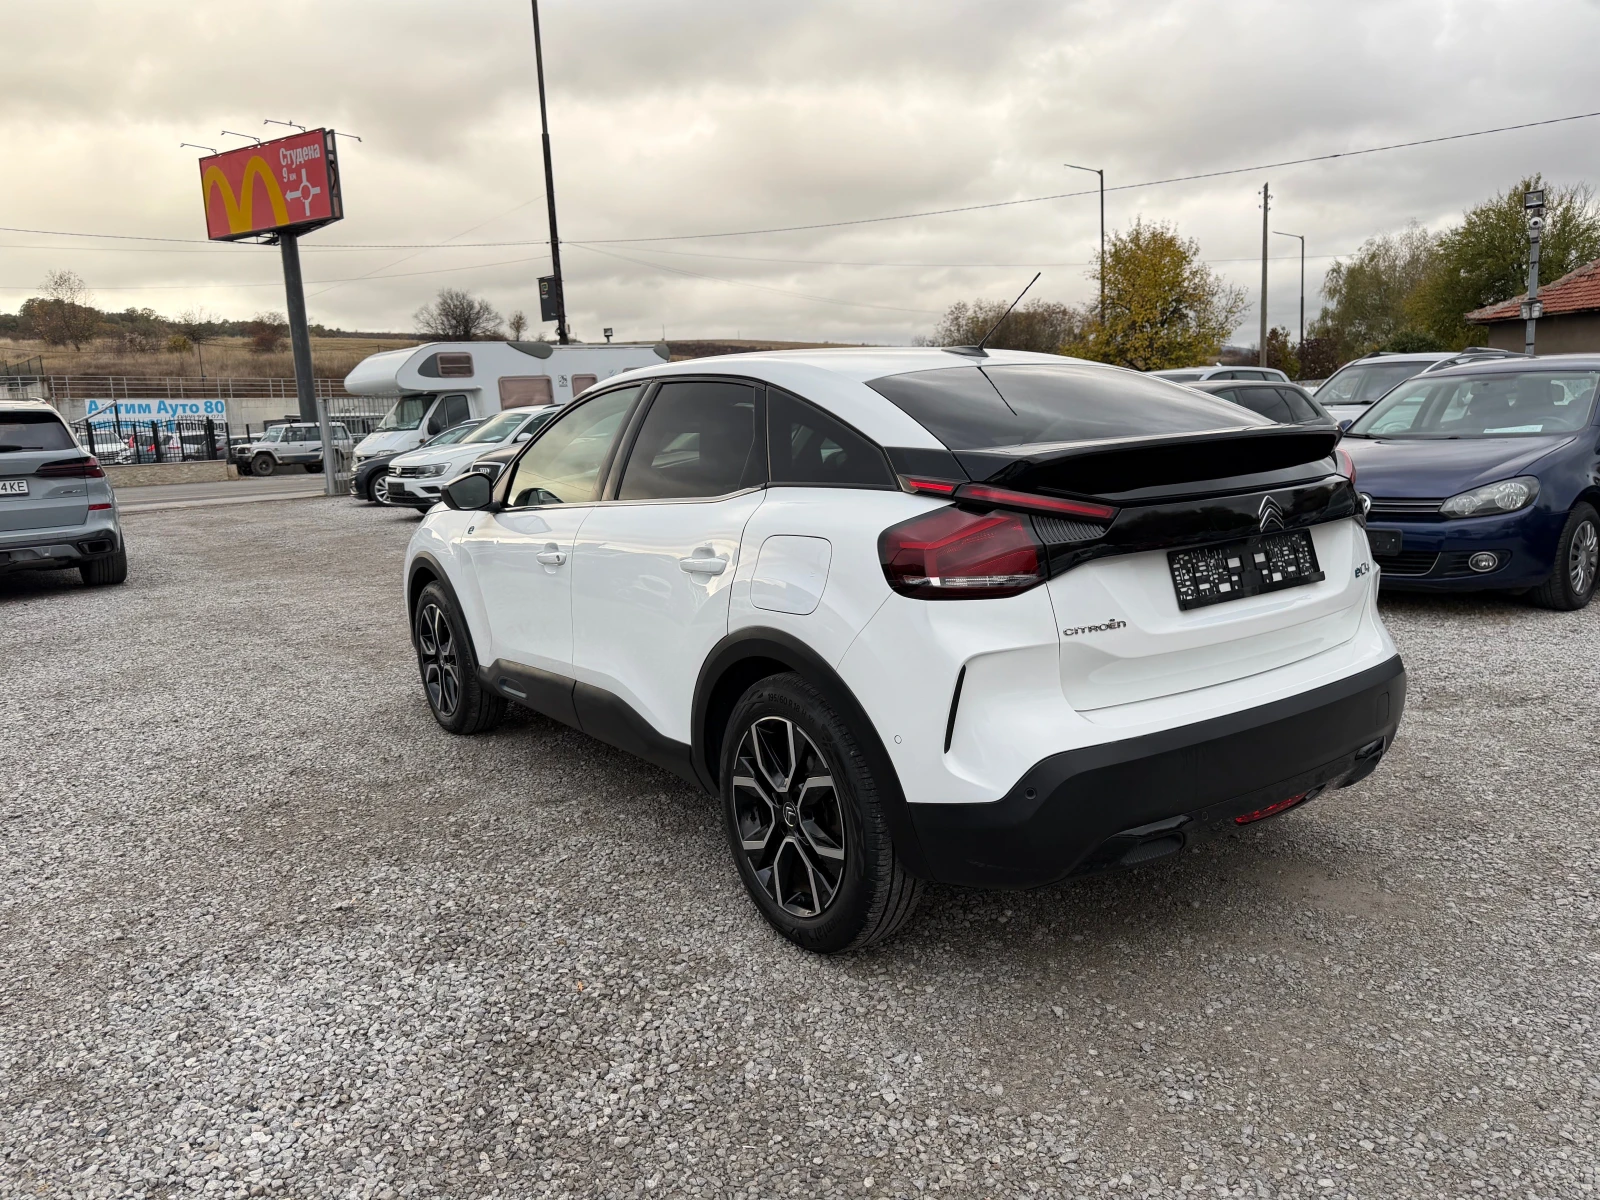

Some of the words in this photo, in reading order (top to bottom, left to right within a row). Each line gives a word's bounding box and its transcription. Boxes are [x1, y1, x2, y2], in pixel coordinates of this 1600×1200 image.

[279, 144, 321, 168] Студена
[282, 167, 288, 182] 9
[156, 399, 200, 418] Ауто
[203, 400, 225, 414] 80
[1063, 618, 1127, 636] CITROËN
